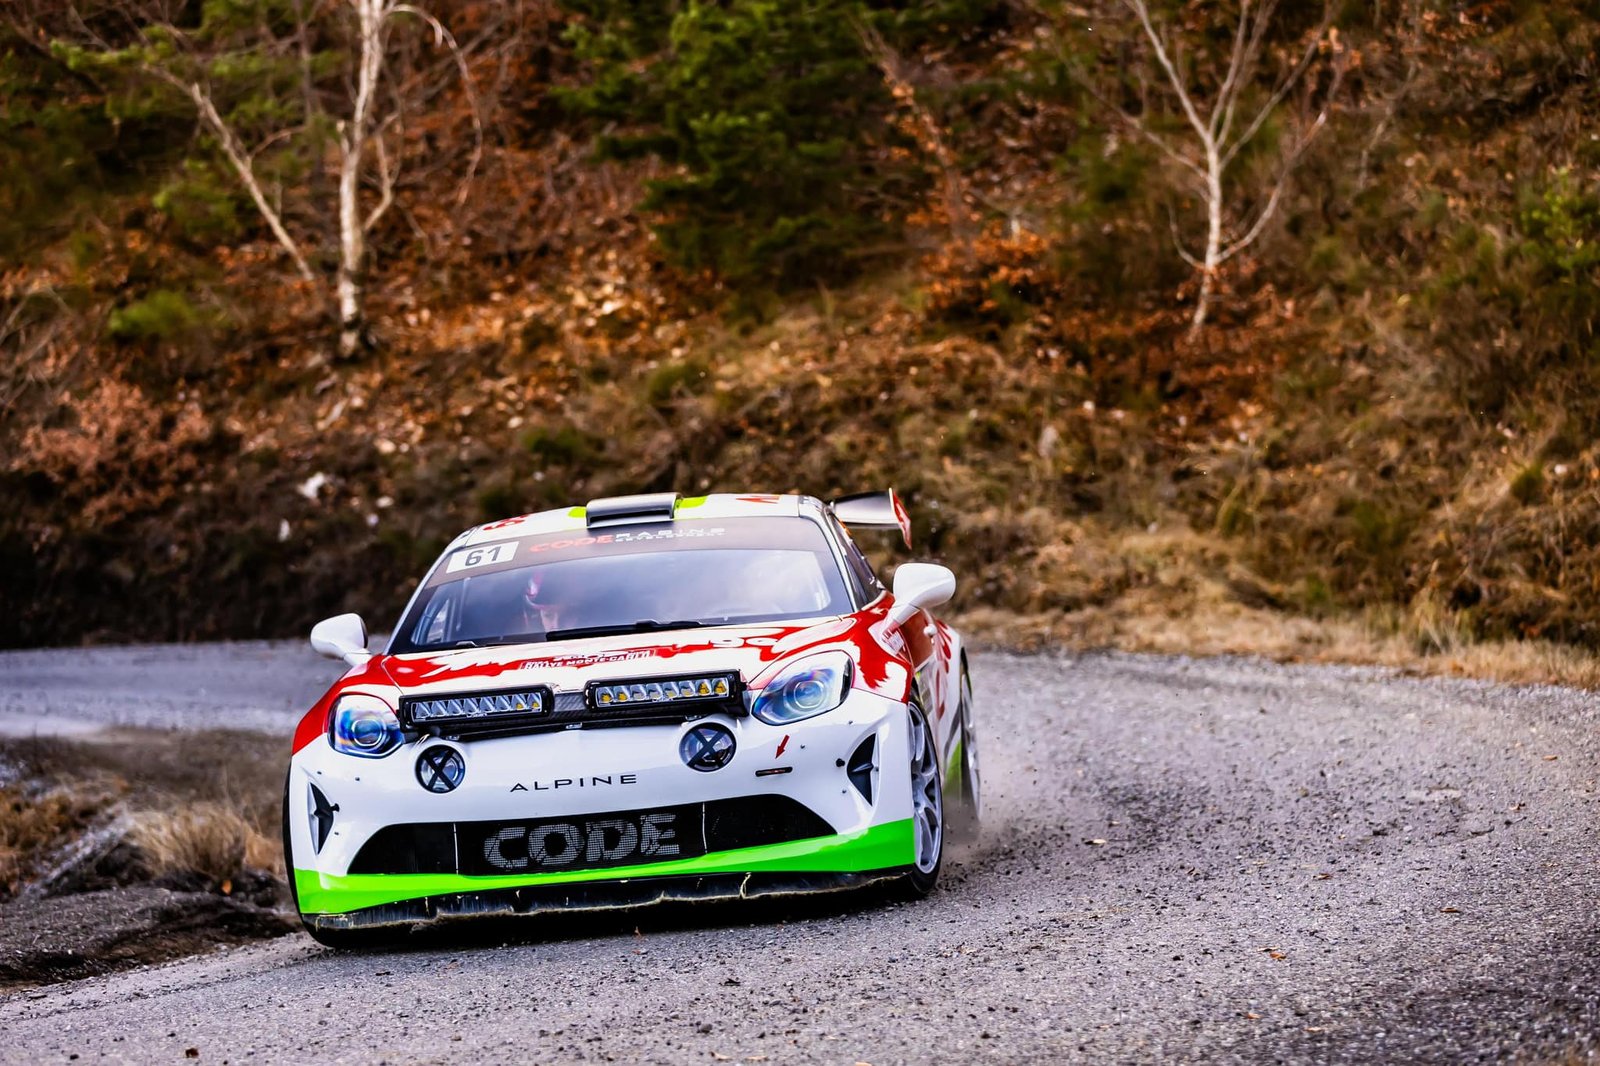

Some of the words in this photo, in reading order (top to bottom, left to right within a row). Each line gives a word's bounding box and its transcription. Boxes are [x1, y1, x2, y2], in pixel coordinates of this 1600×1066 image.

[465, 546, 501, 567] 61
[510, 774, 637, 792] ALPINE
[484, 813, 680, 869] CODE
